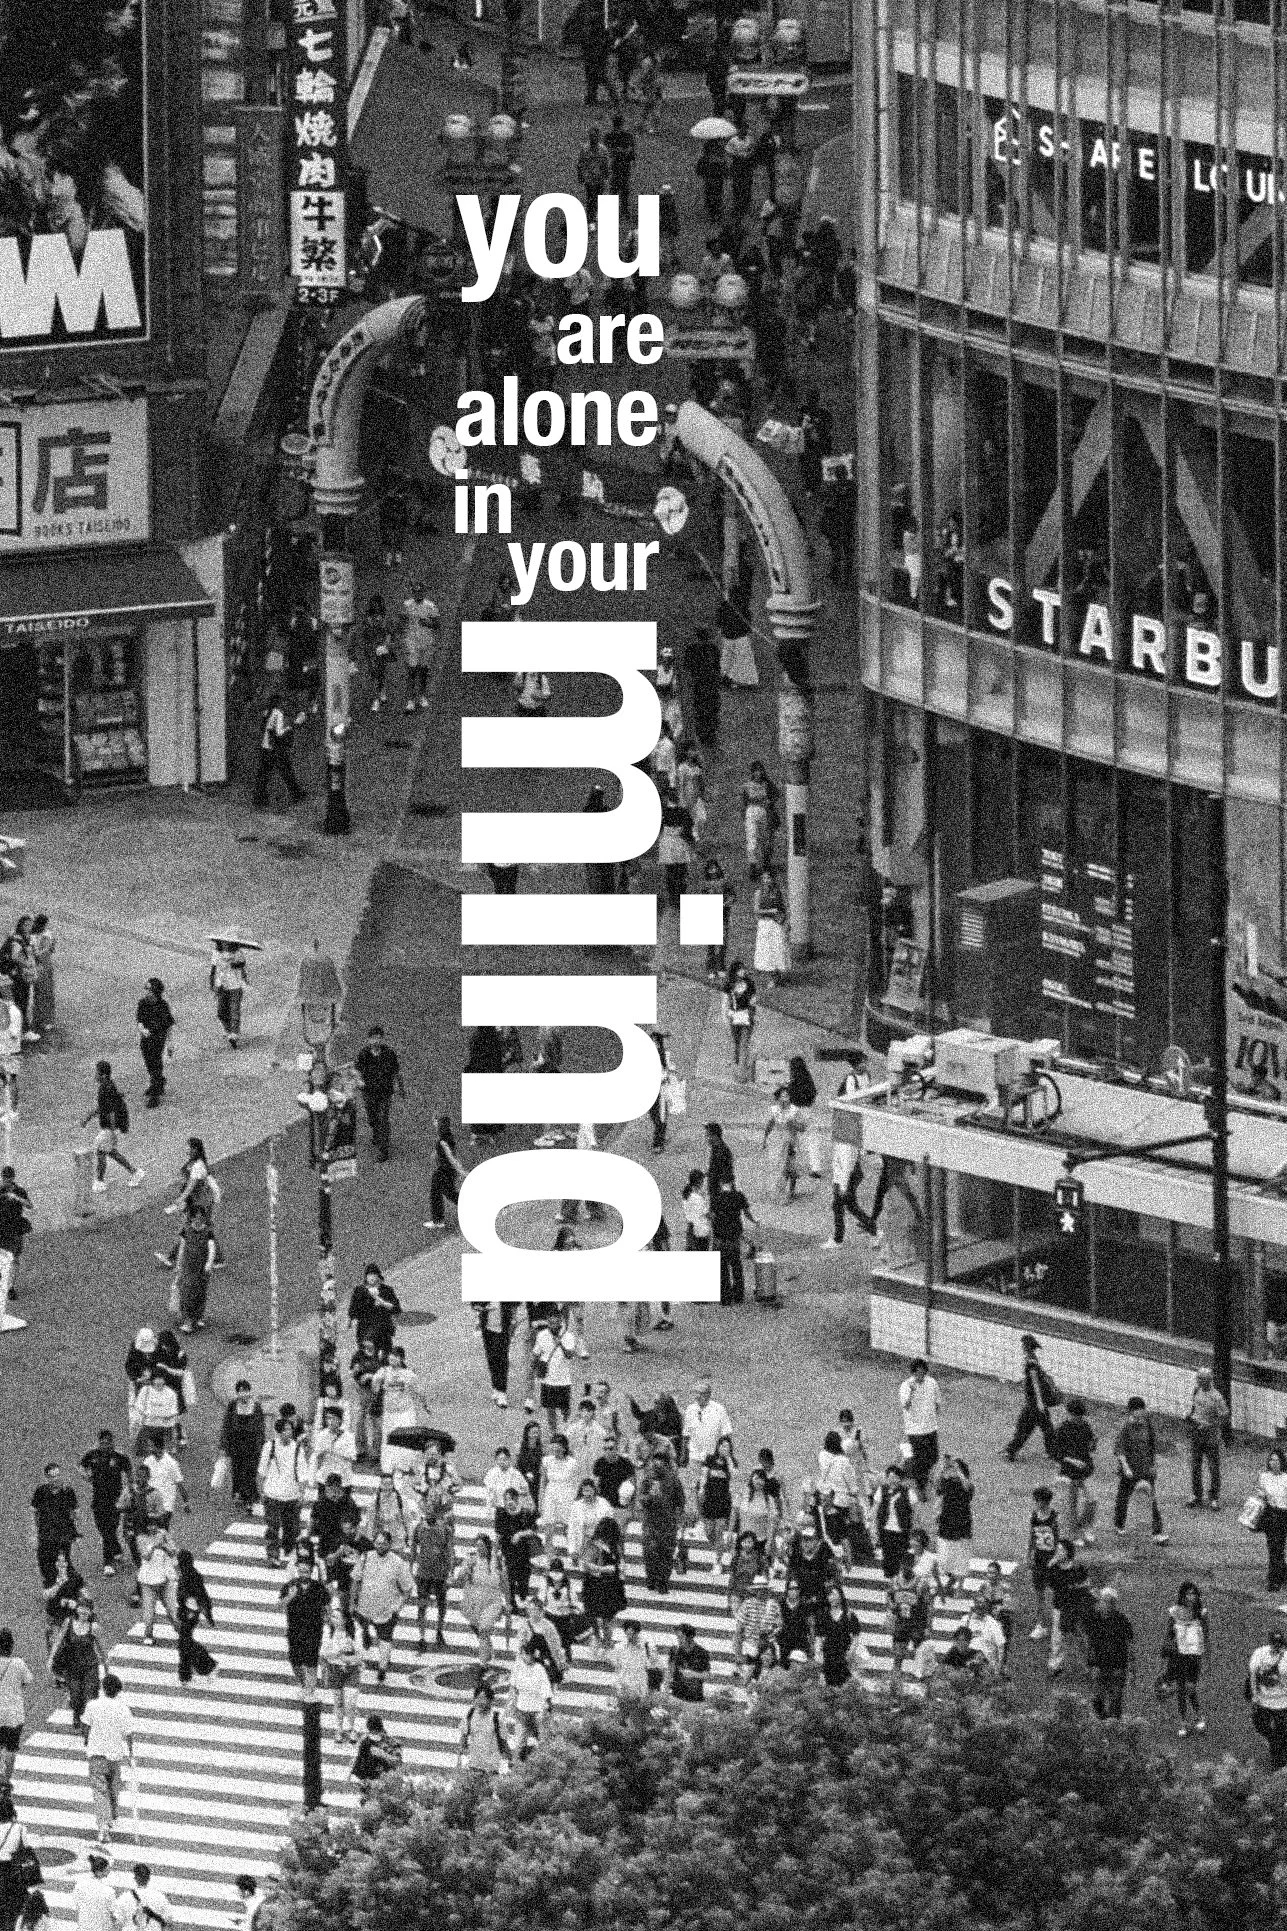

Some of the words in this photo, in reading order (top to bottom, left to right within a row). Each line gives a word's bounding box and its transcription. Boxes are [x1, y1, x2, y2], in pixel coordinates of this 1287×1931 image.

[34, 524, 72, 538] BOOKS
[7, 618, 89, 633] TAISEIDO
[988, 577, 1279, 698] STARBU
